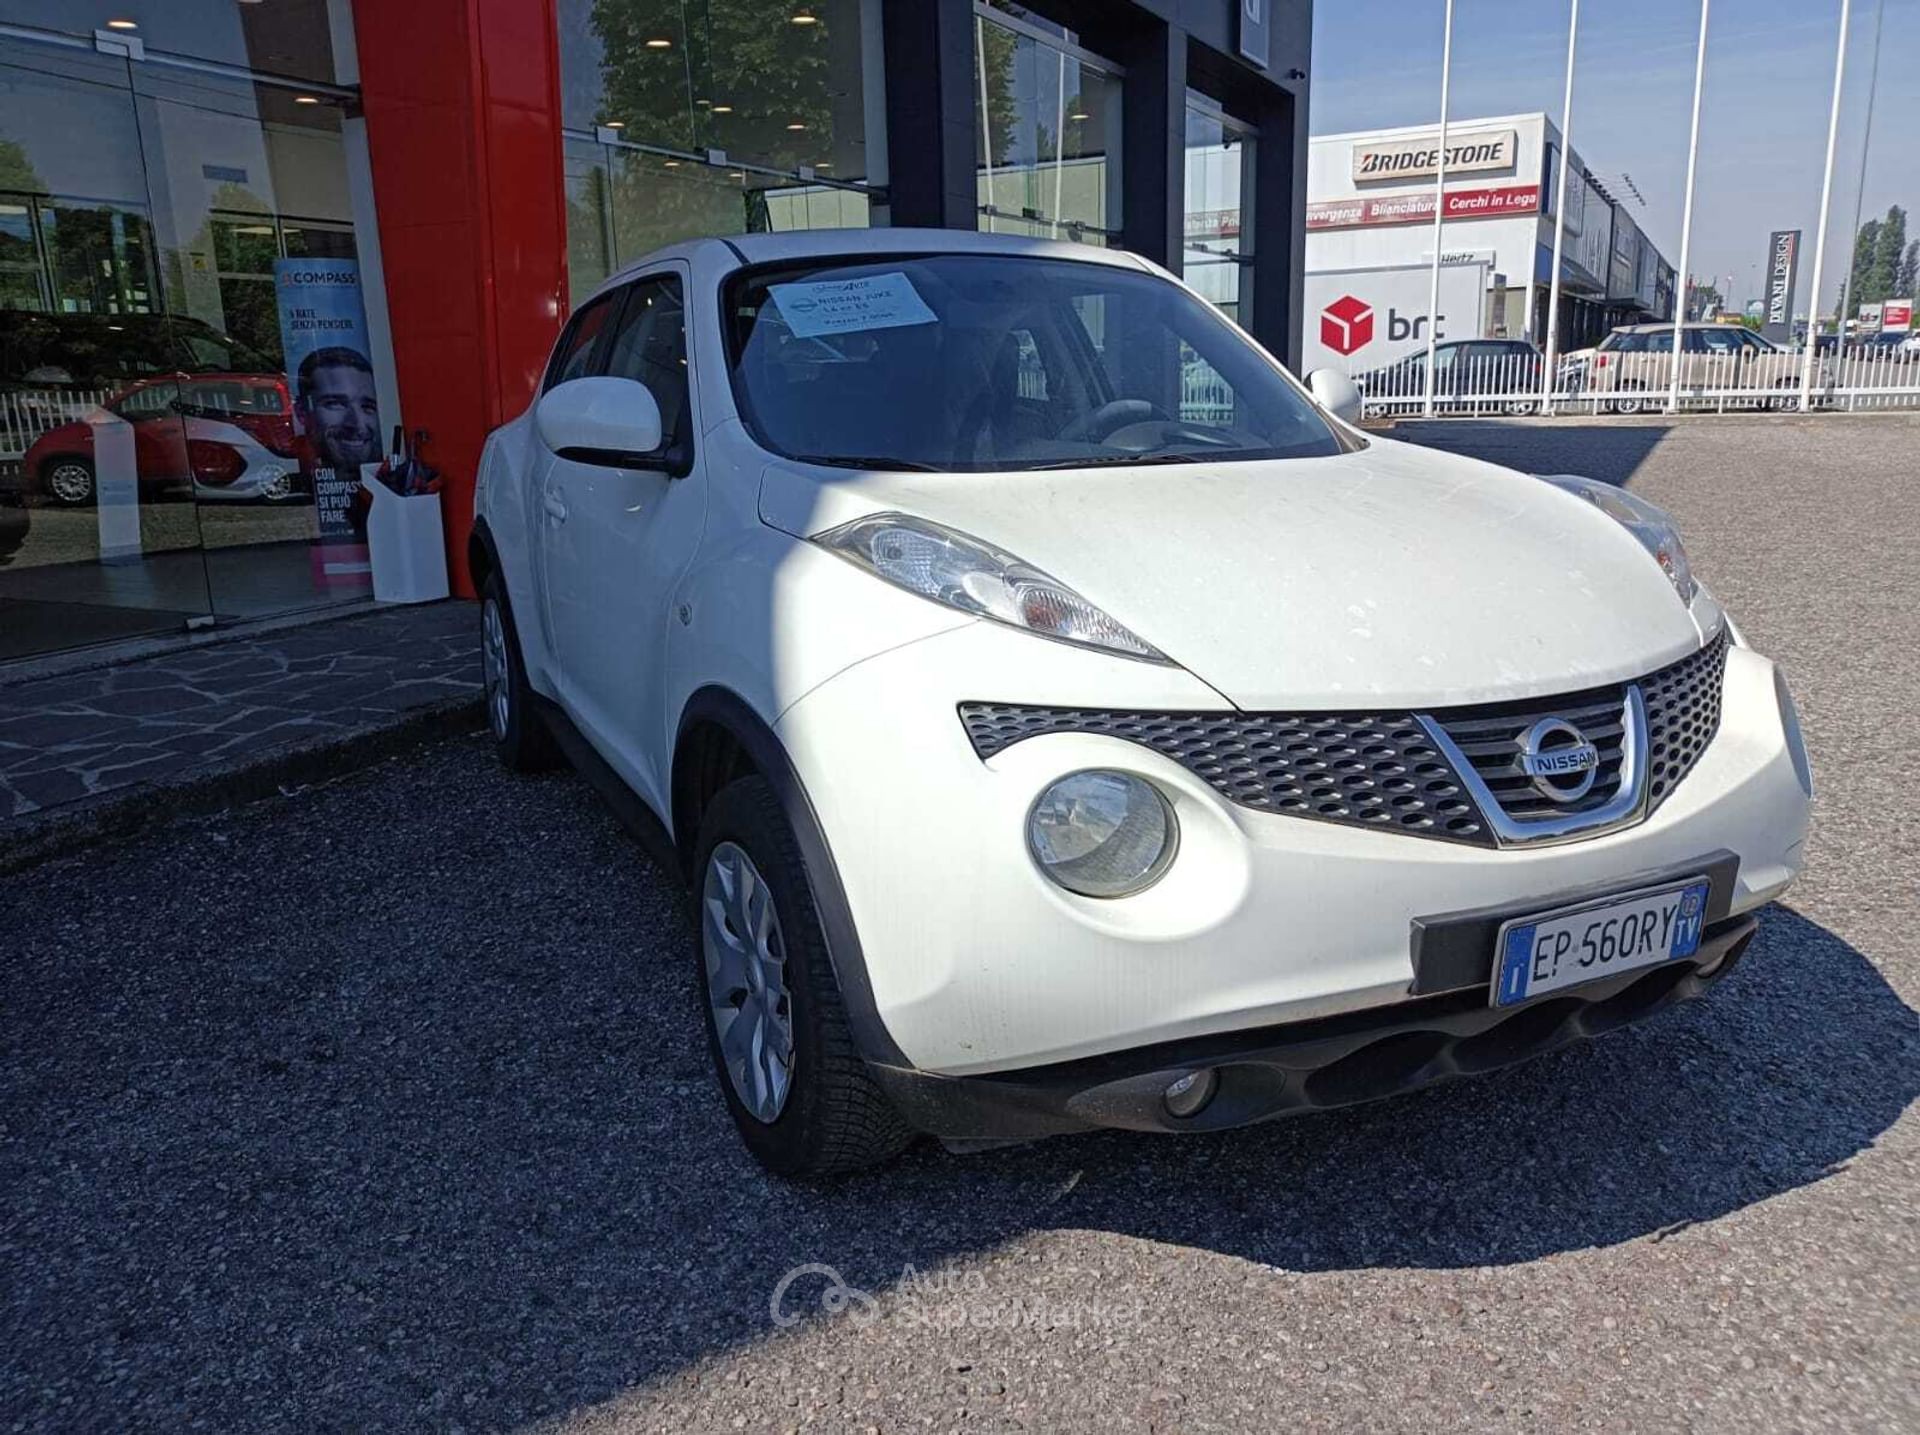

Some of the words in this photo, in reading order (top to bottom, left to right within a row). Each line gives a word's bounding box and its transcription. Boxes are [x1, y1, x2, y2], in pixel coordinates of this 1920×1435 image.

[1359, 142, 1504, 174] BRIDGESTONE
[1449, 195, 1490, 210] Cerchi
[1491, 194, 1503, 206] in
[1506, 193, 1537, 207] Lega
[1774, 234, 1789, 277] DESIGN
[293, 272, 356, 284] COMPASS
[1769, 279, 1785, 324] DIVANI
[291, 320, 315, 330] SENZA
[314, 467, 336, 481] CON
[319, 496, 329, 509] SI
[321, 509, 346, 523] FARE
[1537, 750, 1597, 772] NISSAN
[1676, 915, 1698, 946] TV
[1532, 930, 1572, 982] EP
[1579, 903, 1679, 969] 560RY
